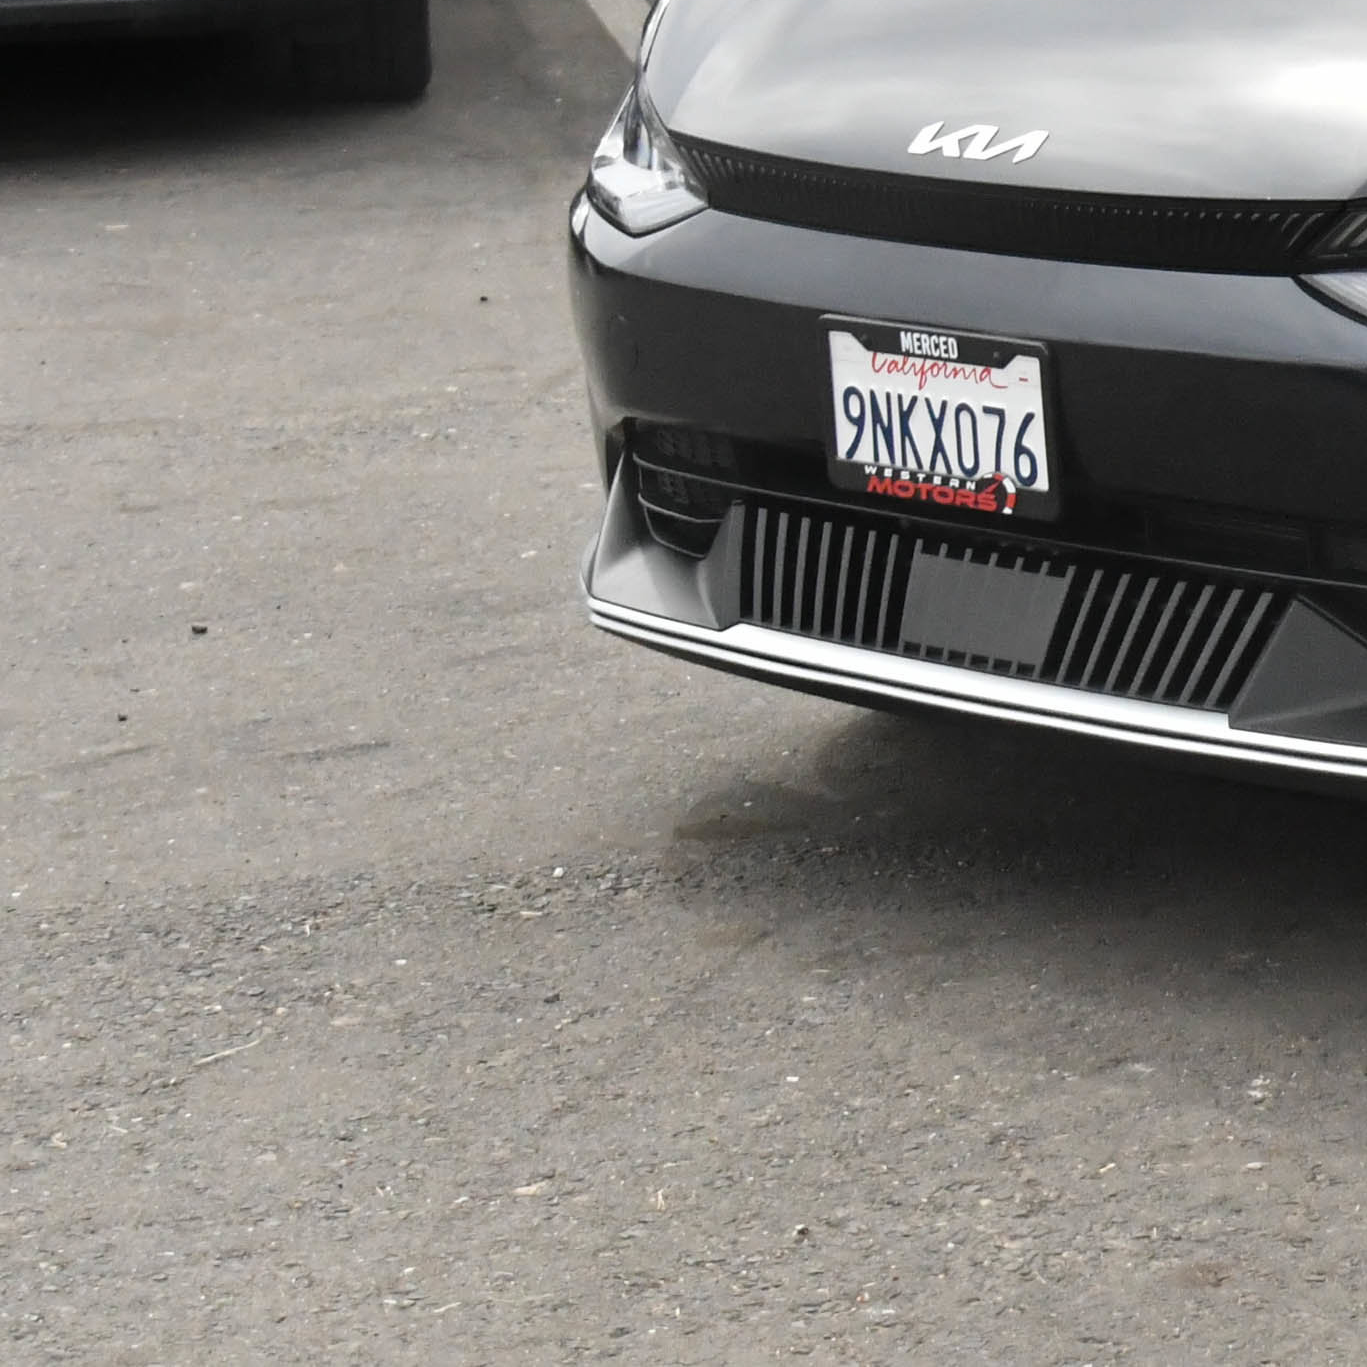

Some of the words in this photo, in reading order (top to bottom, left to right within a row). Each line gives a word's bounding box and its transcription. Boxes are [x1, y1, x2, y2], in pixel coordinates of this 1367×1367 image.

[900, 331, 959, 360] MERCED
[871, 352, 1008, 391] California
[842, 386, 1039, 487] 9NKX076
[864, 465, 976, 490] WESTERN
[866, 475, 998, 512] MOTORS
